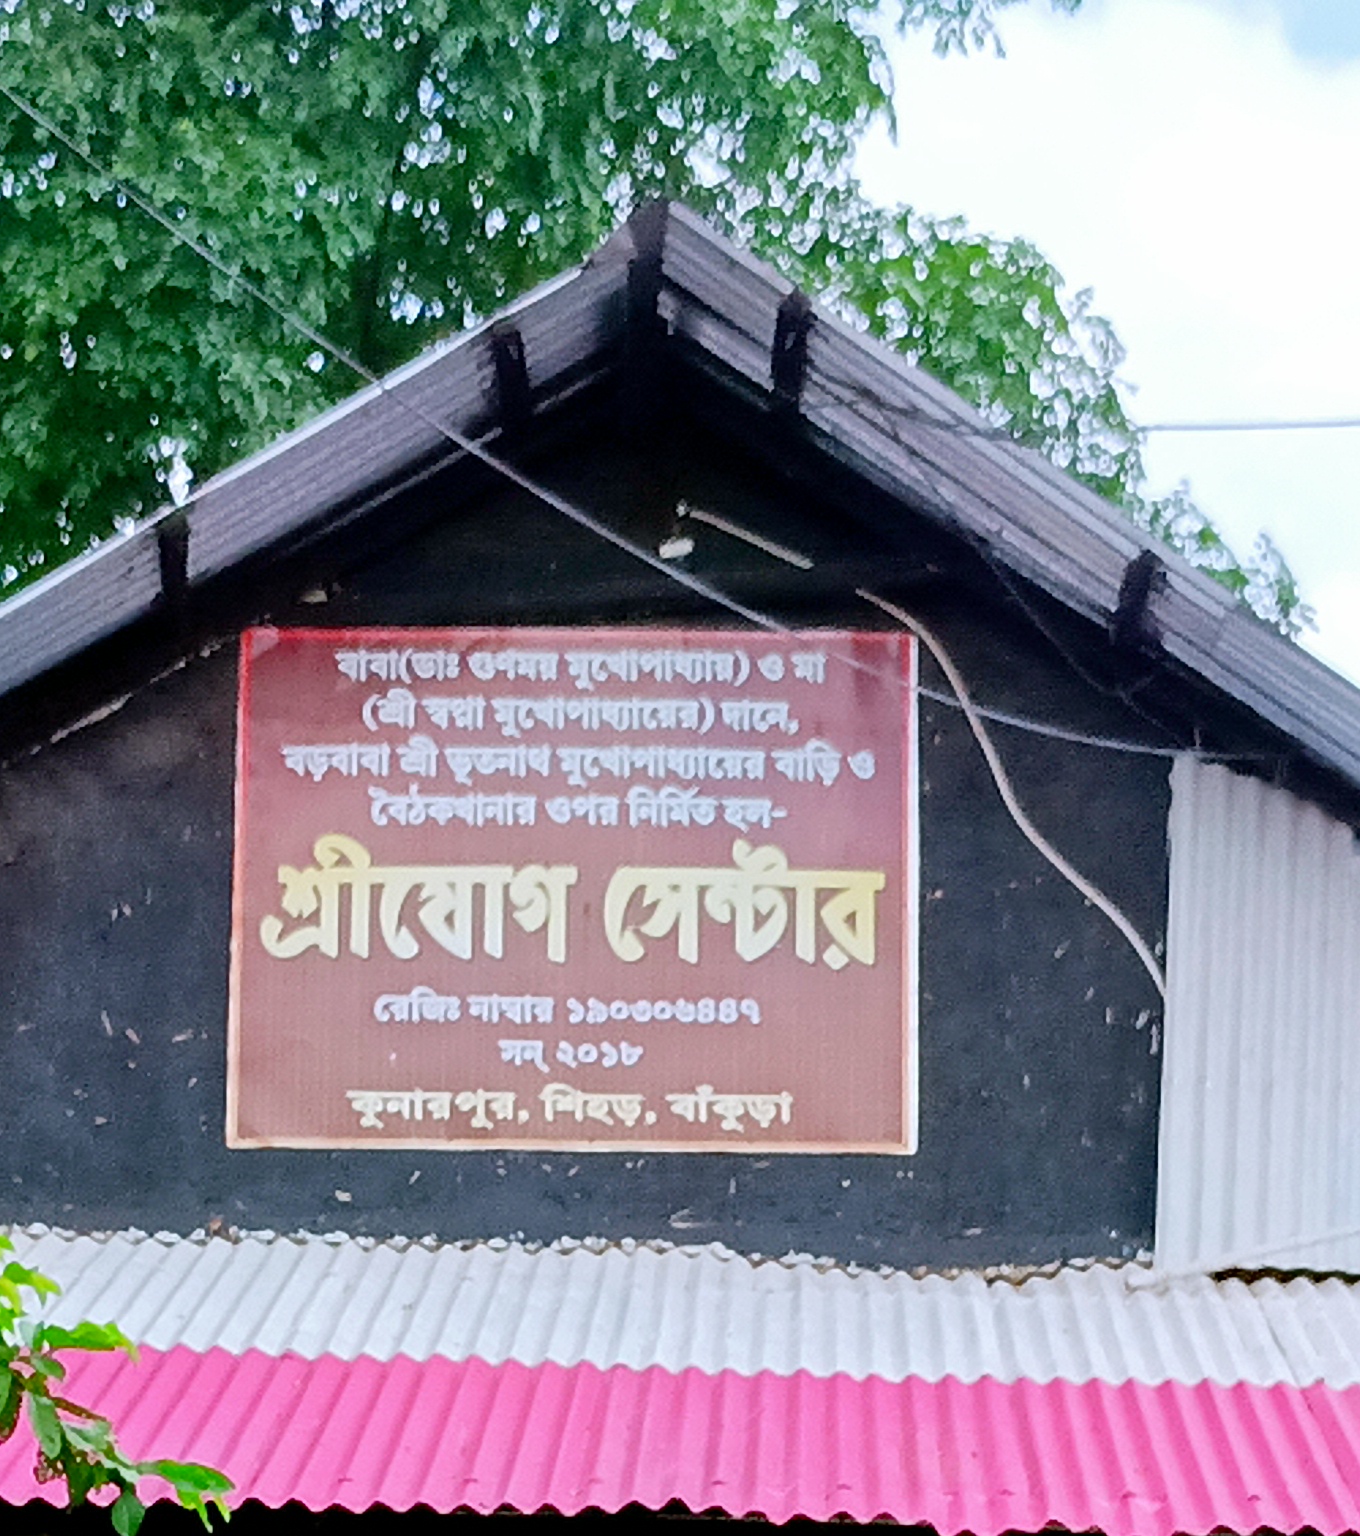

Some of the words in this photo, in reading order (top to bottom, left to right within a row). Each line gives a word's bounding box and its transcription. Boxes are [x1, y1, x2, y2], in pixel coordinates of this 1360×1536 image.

[565, 649, 750, 690] মুখোপাধ্যায়)
[758, 655, 784, 681] ও
[792, 651, 826, 683] মা
[493, 694, 714, 735] মুখোপাধ্যায়ের)
[281, 742, 390, 782] বড়বাবা
[399, 734, 439, 780] শ্রী
[557, 743, 765, 787] মুখোপাধ্যায়ের
[774, 744, 841, 787] বাড়ি
[847, 749, 876, 780] ও
[369, 782, 536, 828] বৈঠকখানার
[545, 793, 619, 828] ওপর
[627, 784, 714, 829] নির্মিত
[258, 832, 579, 965] শ্রীযোগ
[603, 838, 887, 972] সেন্টার
[556, 1039, 645, 1070] ২০১৮
[665, 1081, 795, 1133] বাঁকুড়া
